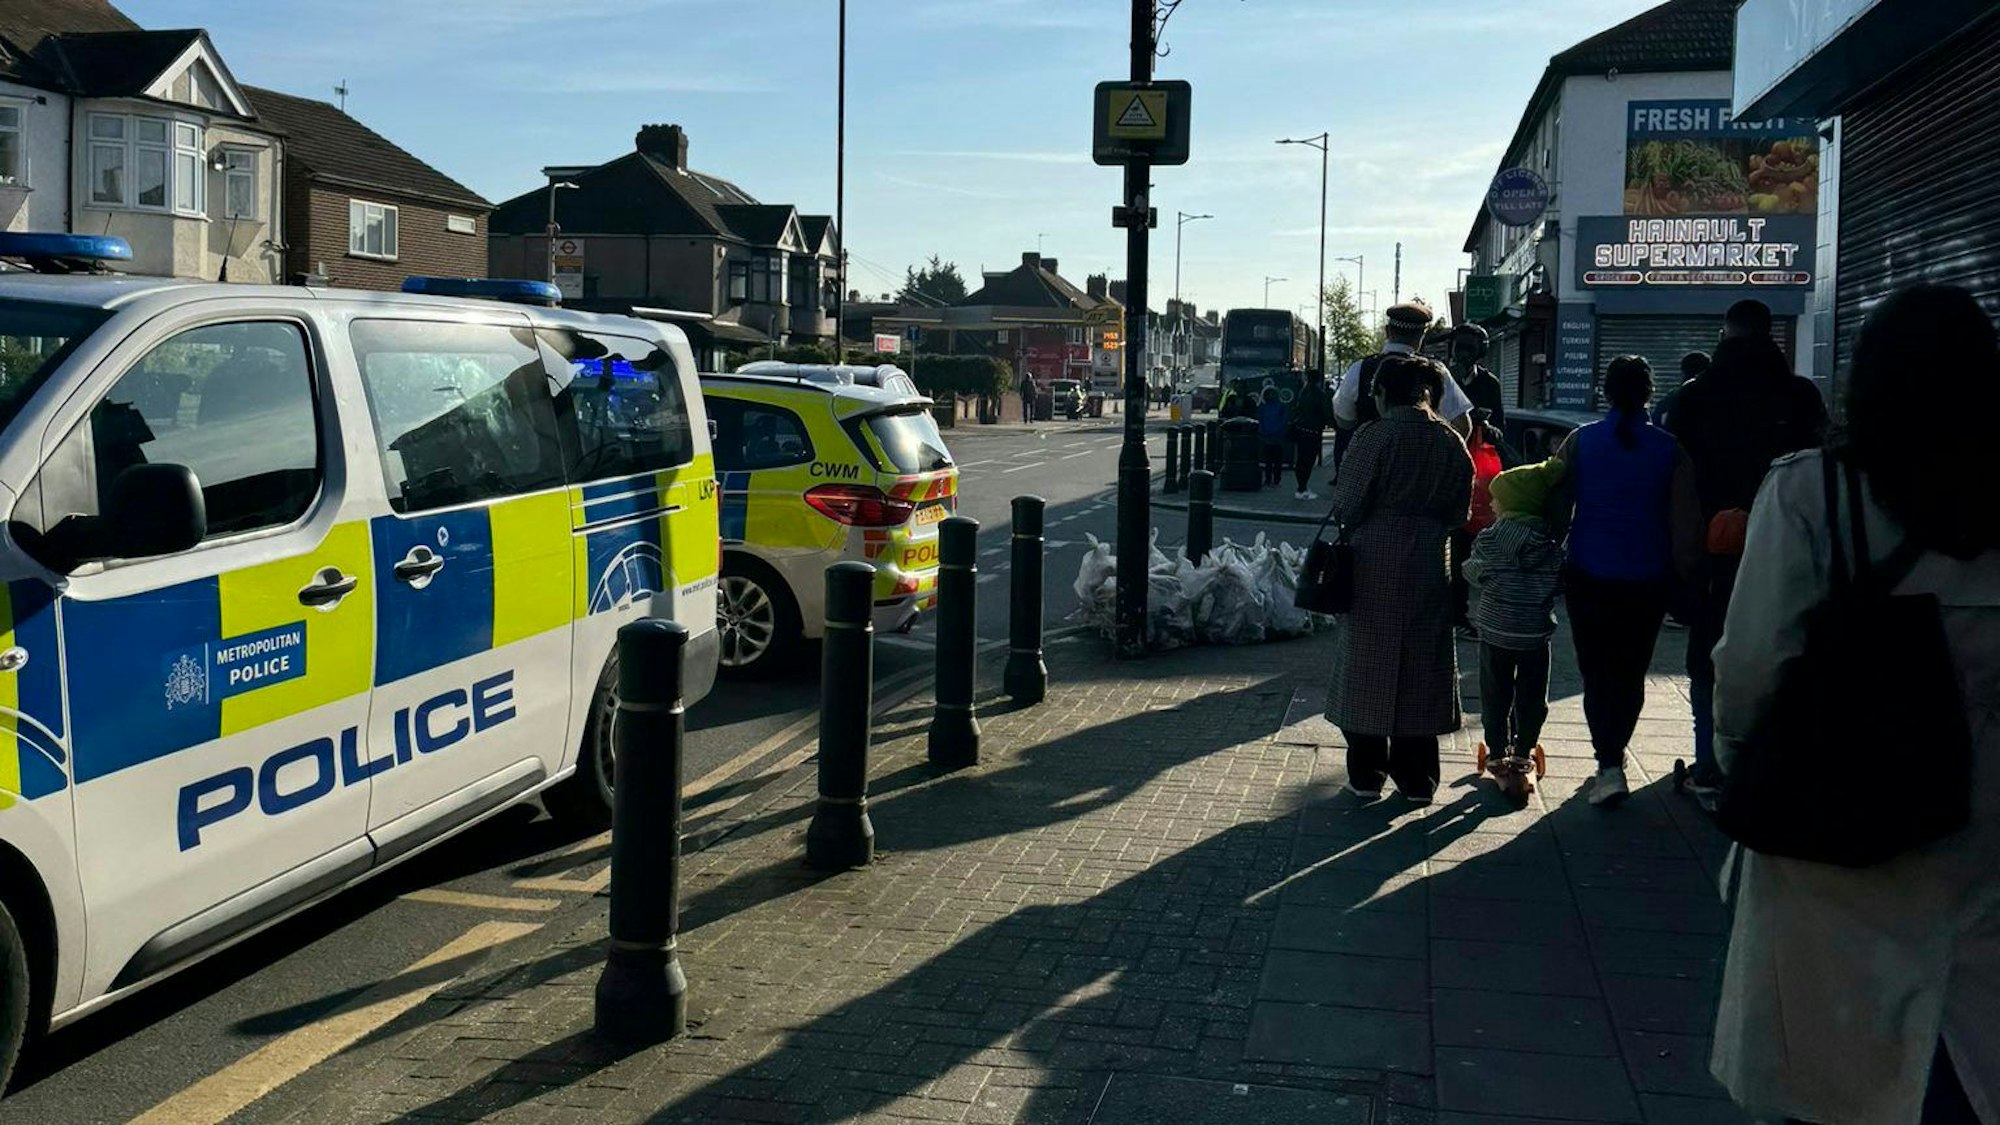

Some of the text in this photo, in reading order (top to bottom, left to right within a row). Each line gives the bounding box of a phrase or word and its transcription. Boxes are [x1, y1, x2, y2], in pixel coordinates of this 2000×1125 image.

[1634, 108, 1710, 131] FRESH
[1503, 188, 1535, 198] OPEN
[1518, 201, 1543, 210] LATE
[1628, 218, 1766, 243] HAINAULT
[1595, 243, 1799, 267] SUPERMARKET
[1562, 322, 1591, 330] ENGLISH
[1562, 337, 1590, 345] TURKISH
[1564, 352, 1588, 360] POLISH
[810, 462, 860, 479] CWM
[903, 545, 939, 566] POL
[216, 631, 300, 665] METROPOLITAN
[230, 655, 290, 686] POLICE
[177, 669, 516, 852] POLICE
